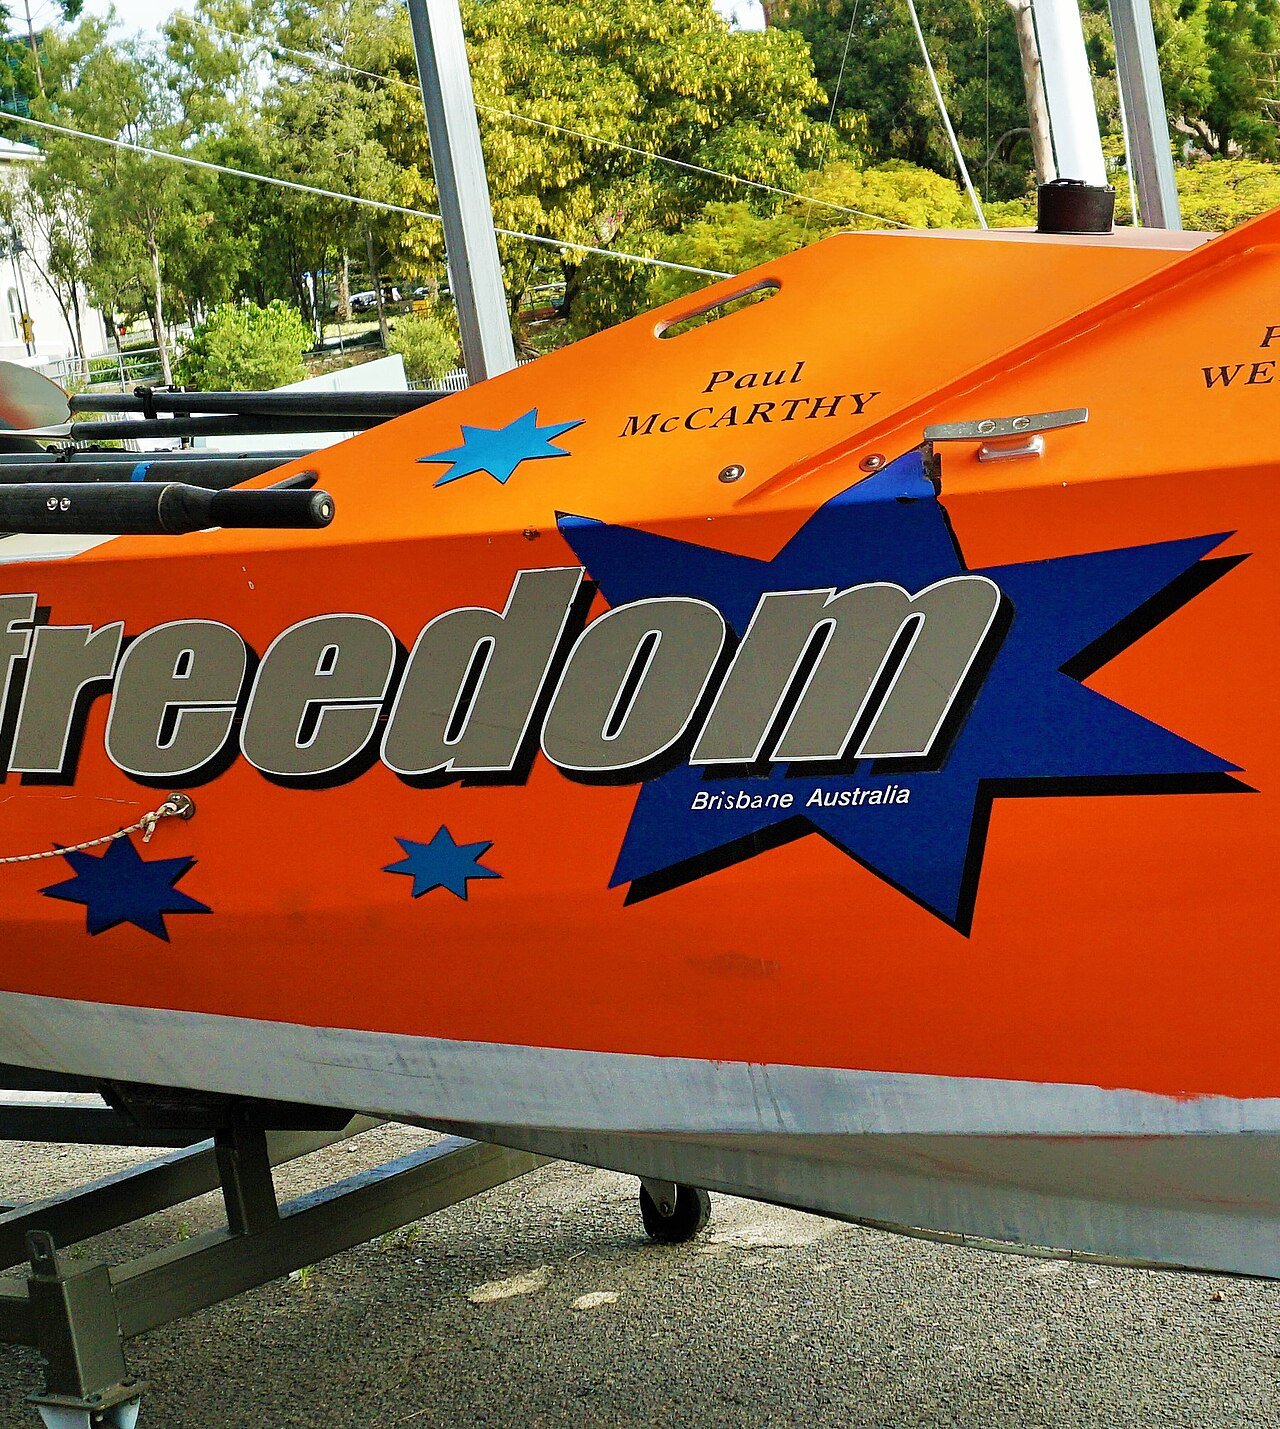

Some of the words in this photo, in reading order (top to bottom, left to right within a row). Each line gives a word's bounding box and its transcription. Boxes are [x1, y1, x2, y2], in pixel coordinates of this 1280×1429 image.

[701, 360, 806, 394] Paul
[617, 391, 882, 438] McCARTHY
[690, 790, 794, 810] Brisbane
[805, 784, 911, 808] Australia
